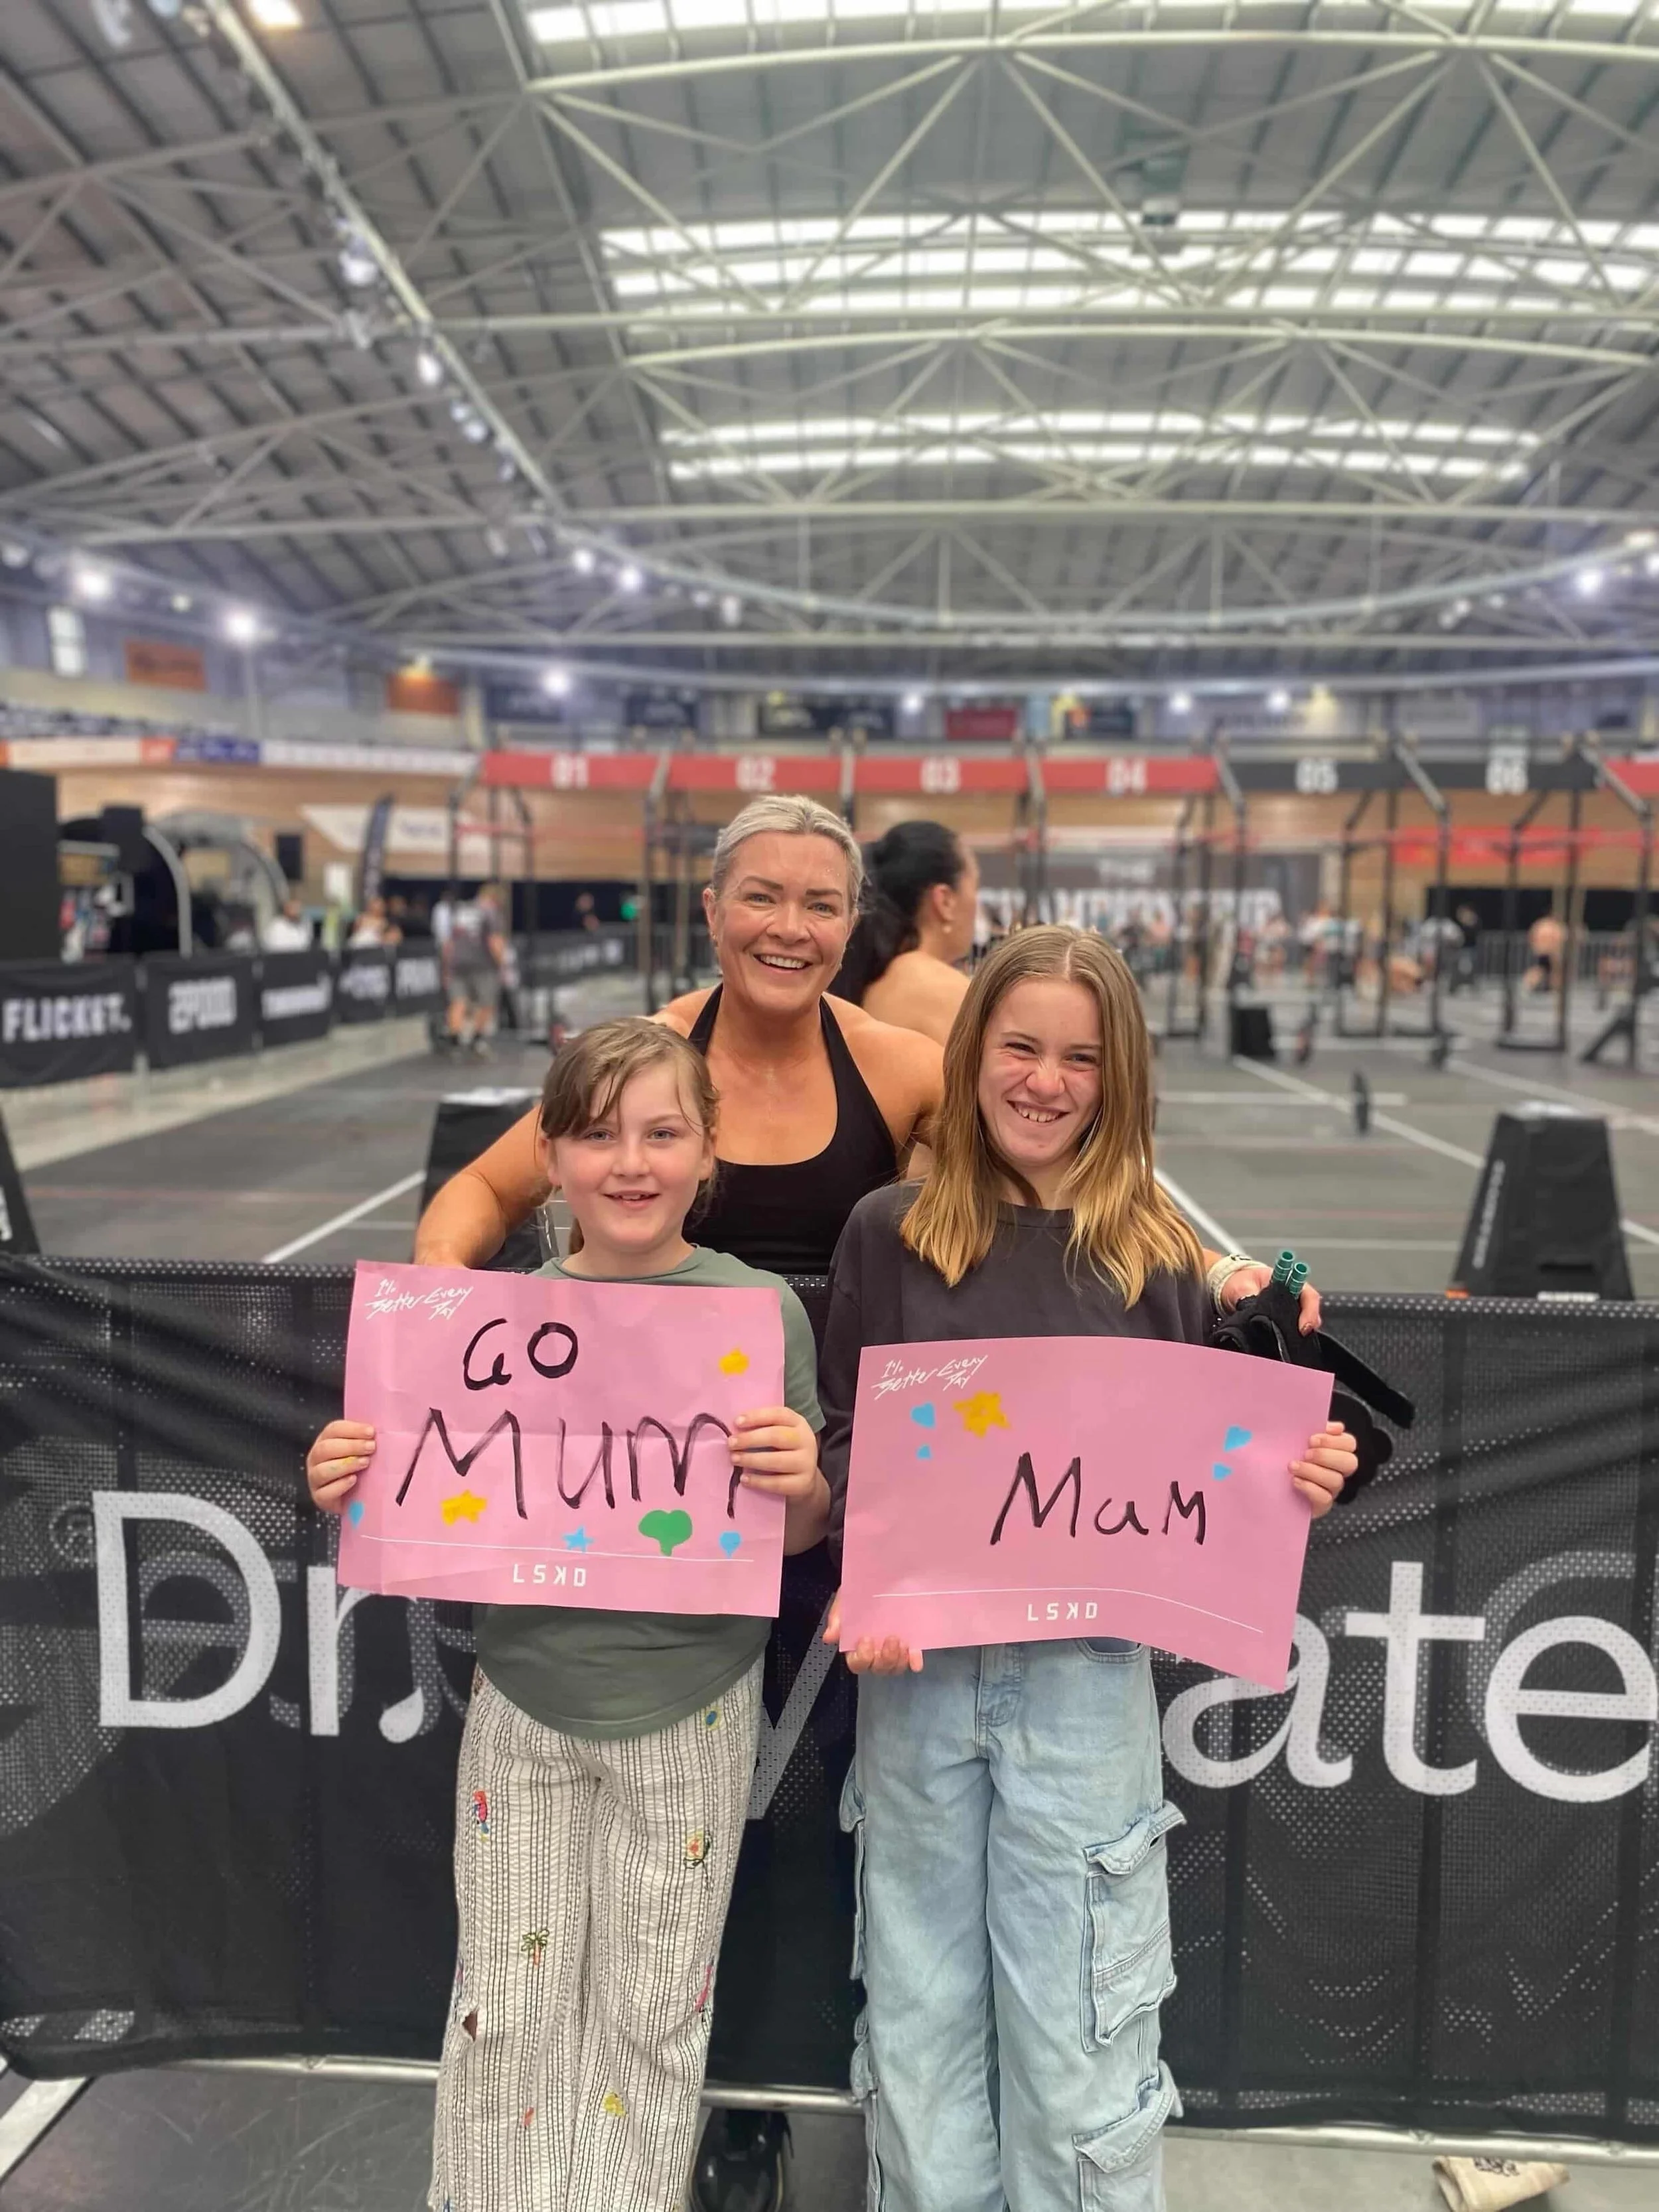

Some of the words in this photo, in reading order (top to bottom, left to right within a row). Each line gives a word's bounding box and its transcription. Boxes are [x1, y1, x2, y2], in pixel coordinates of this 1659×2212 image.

[551, 757, 589, 788] 01
[735, 757, 776, 791] 02
[920, 757, 961, 793] 03
[1107, 758, 1147, 793] 04
[1295, 756, 1338, 793] 05
[1486, 756, 1528, 794] 06
